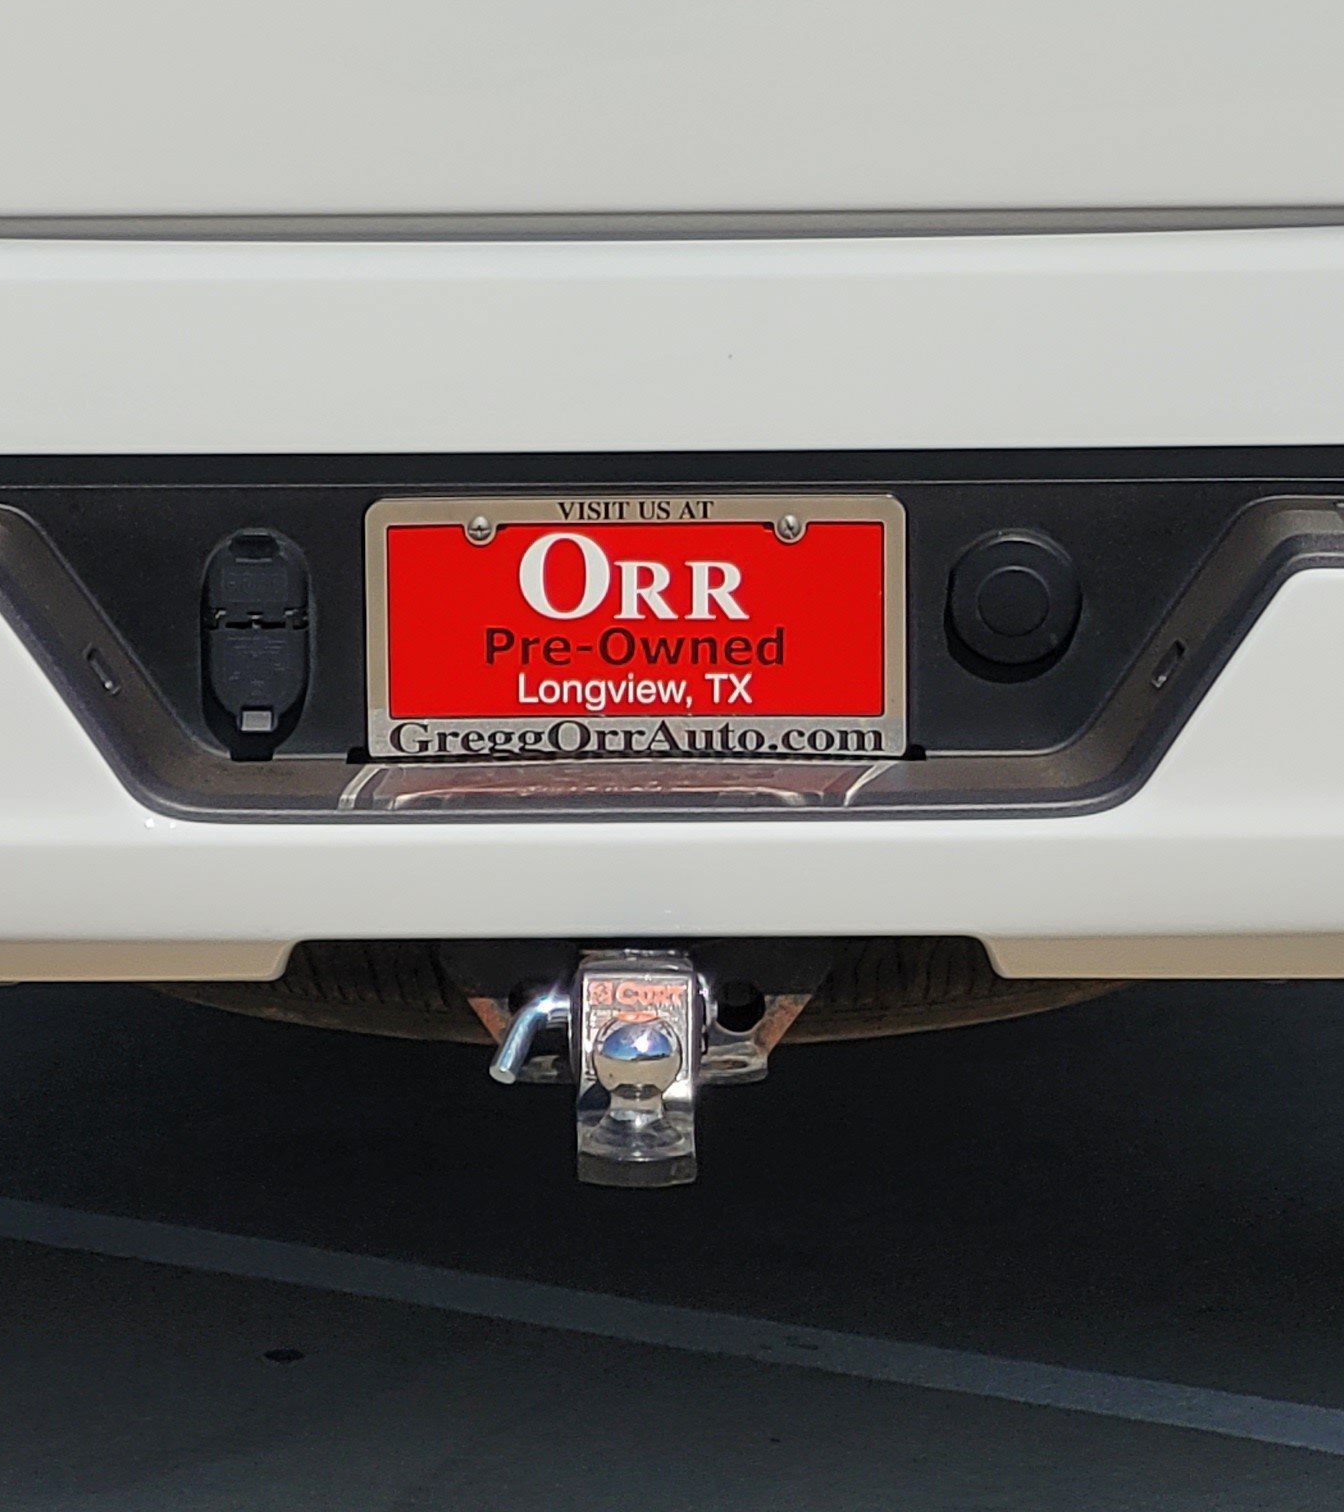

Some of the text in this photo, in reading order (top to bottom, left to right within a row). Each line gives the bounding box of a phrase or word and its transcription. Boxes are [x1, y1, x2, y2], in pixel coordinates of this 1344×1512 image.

[558, 499, 715, 521] VISIT US AT
[484, 625, 787, 667] Pre-Owned
[517, 672, 753, 711] Longview, TX
[388, 719, 884, 755] GreggOrrAuto.com
